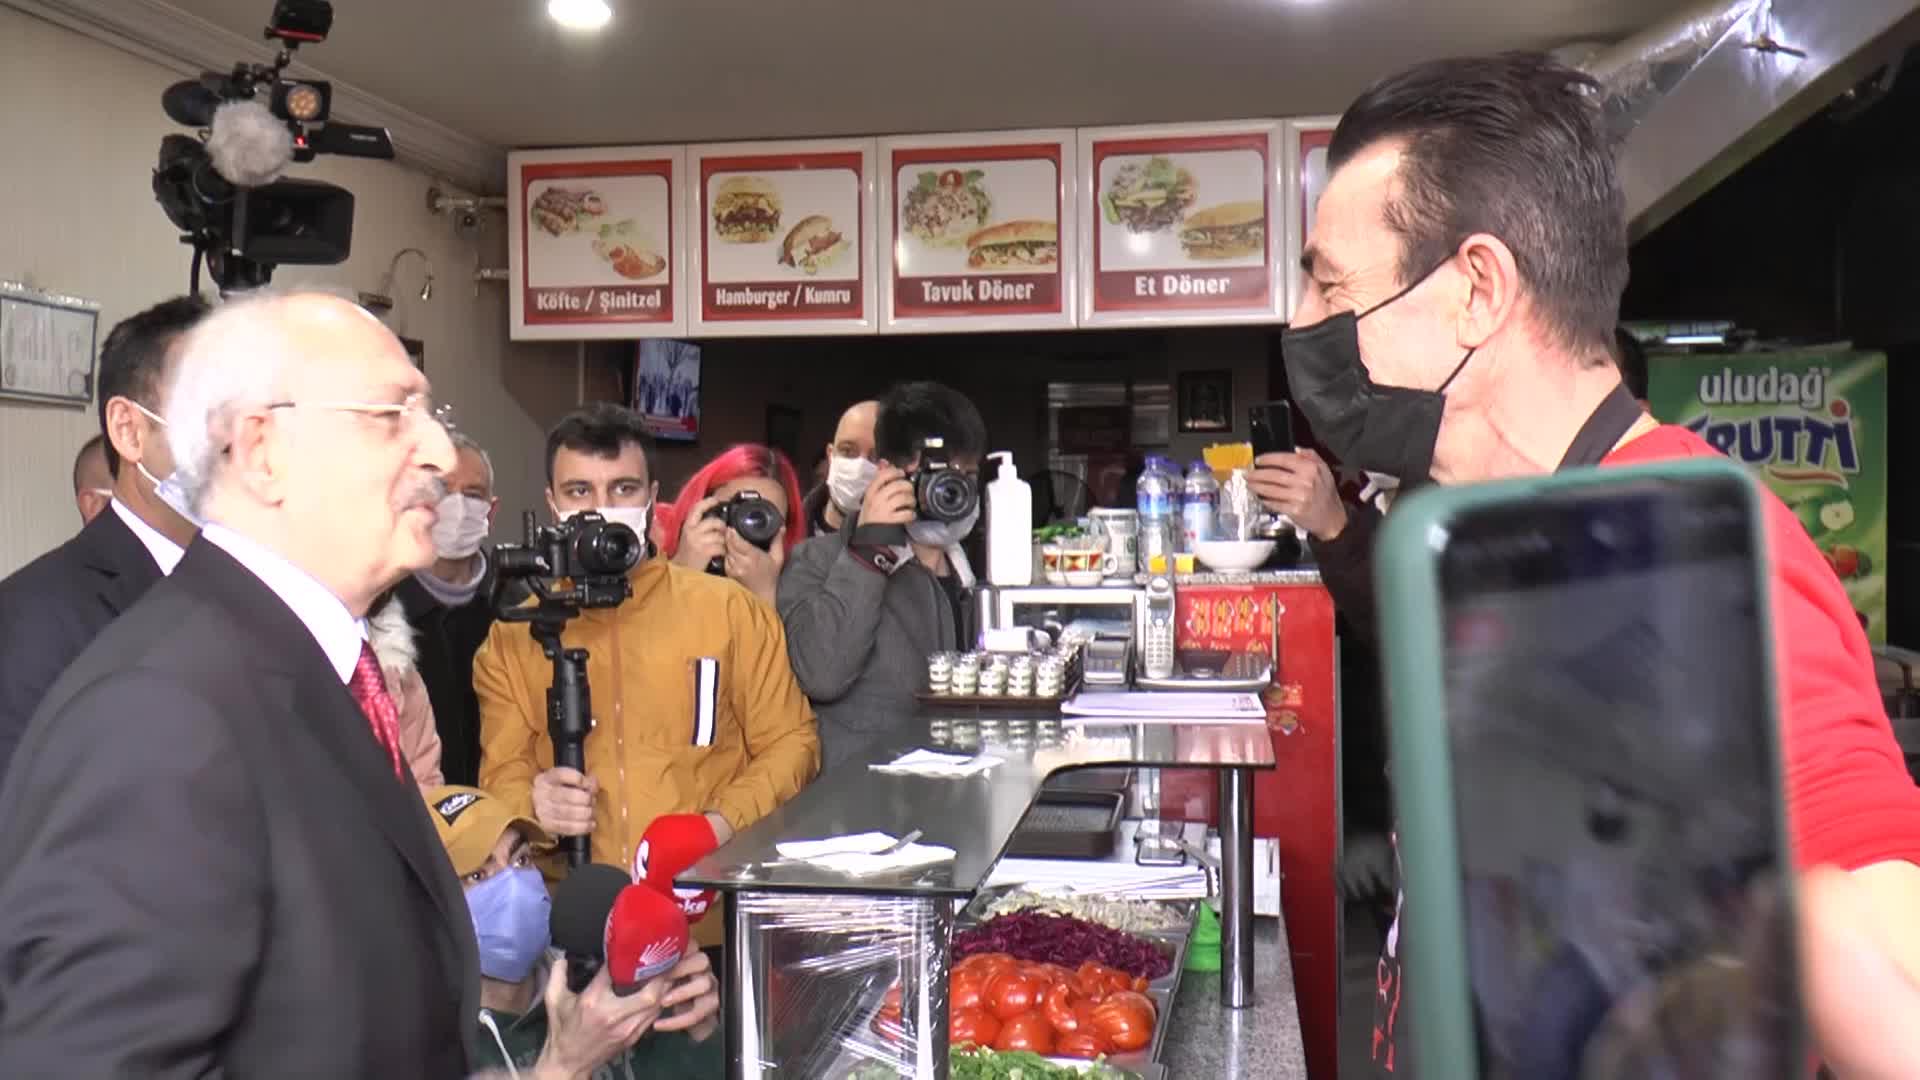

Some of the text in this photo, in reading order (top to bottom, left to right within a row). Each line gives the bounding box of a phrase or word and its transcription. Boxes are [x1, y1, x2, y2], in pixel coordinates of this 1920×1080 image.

[921, 281, 1035, 302] Tavuk Döner
[1135, 274, 1231, 295] Et Döner
[537, 291, 581, 311] Köfte
[599, 289, 661, 313] Şinitzel
[716, 287, 789, 309] Hamburger
[805, 286, 851, 305] Kumru
